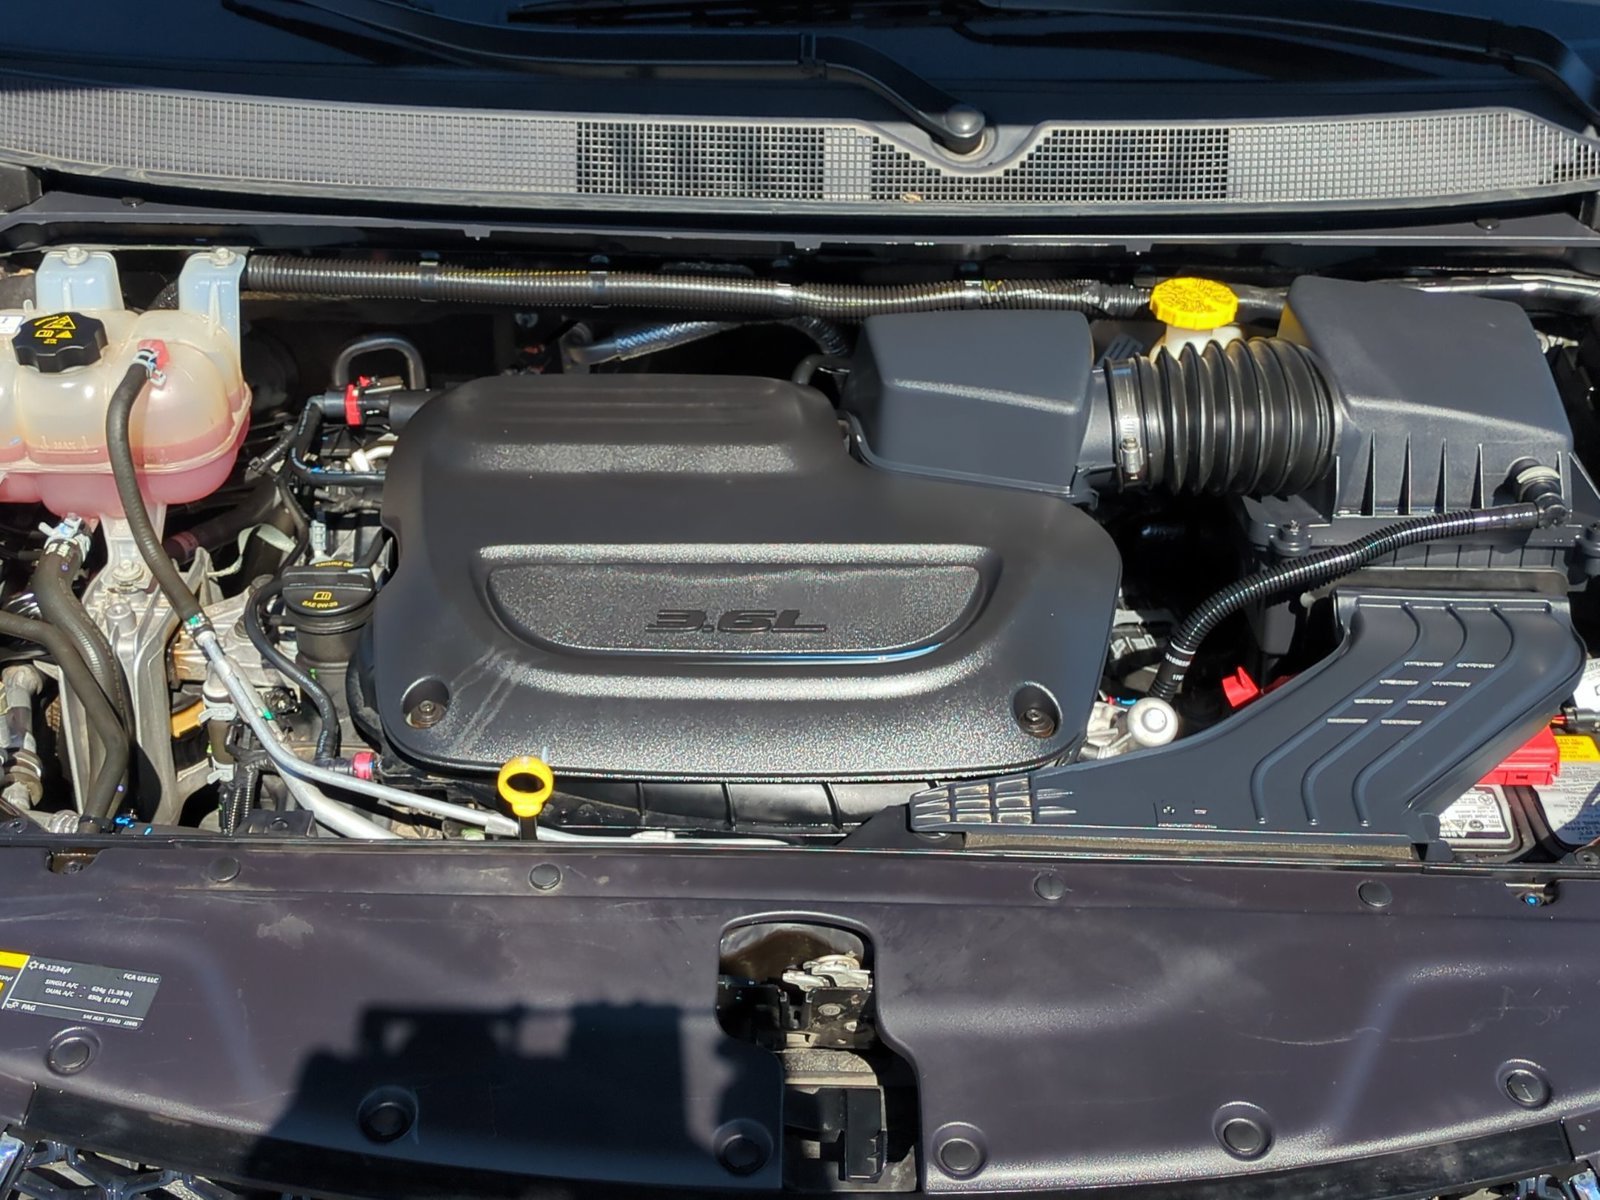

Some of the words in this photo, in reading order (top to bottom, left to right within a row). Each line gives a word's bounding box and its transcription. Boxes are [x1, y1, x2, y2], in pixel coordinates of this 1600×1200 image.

[645, 609, 827, 633] 3.6L
[38, 963, 72, 974] R-1234yf
[45, 979, 67, 987] SINGLE
[123, 973, 136, 981] FCA
[146, 976, 159, 984] LLC
[20, 1003, 37, 1011] PAG
